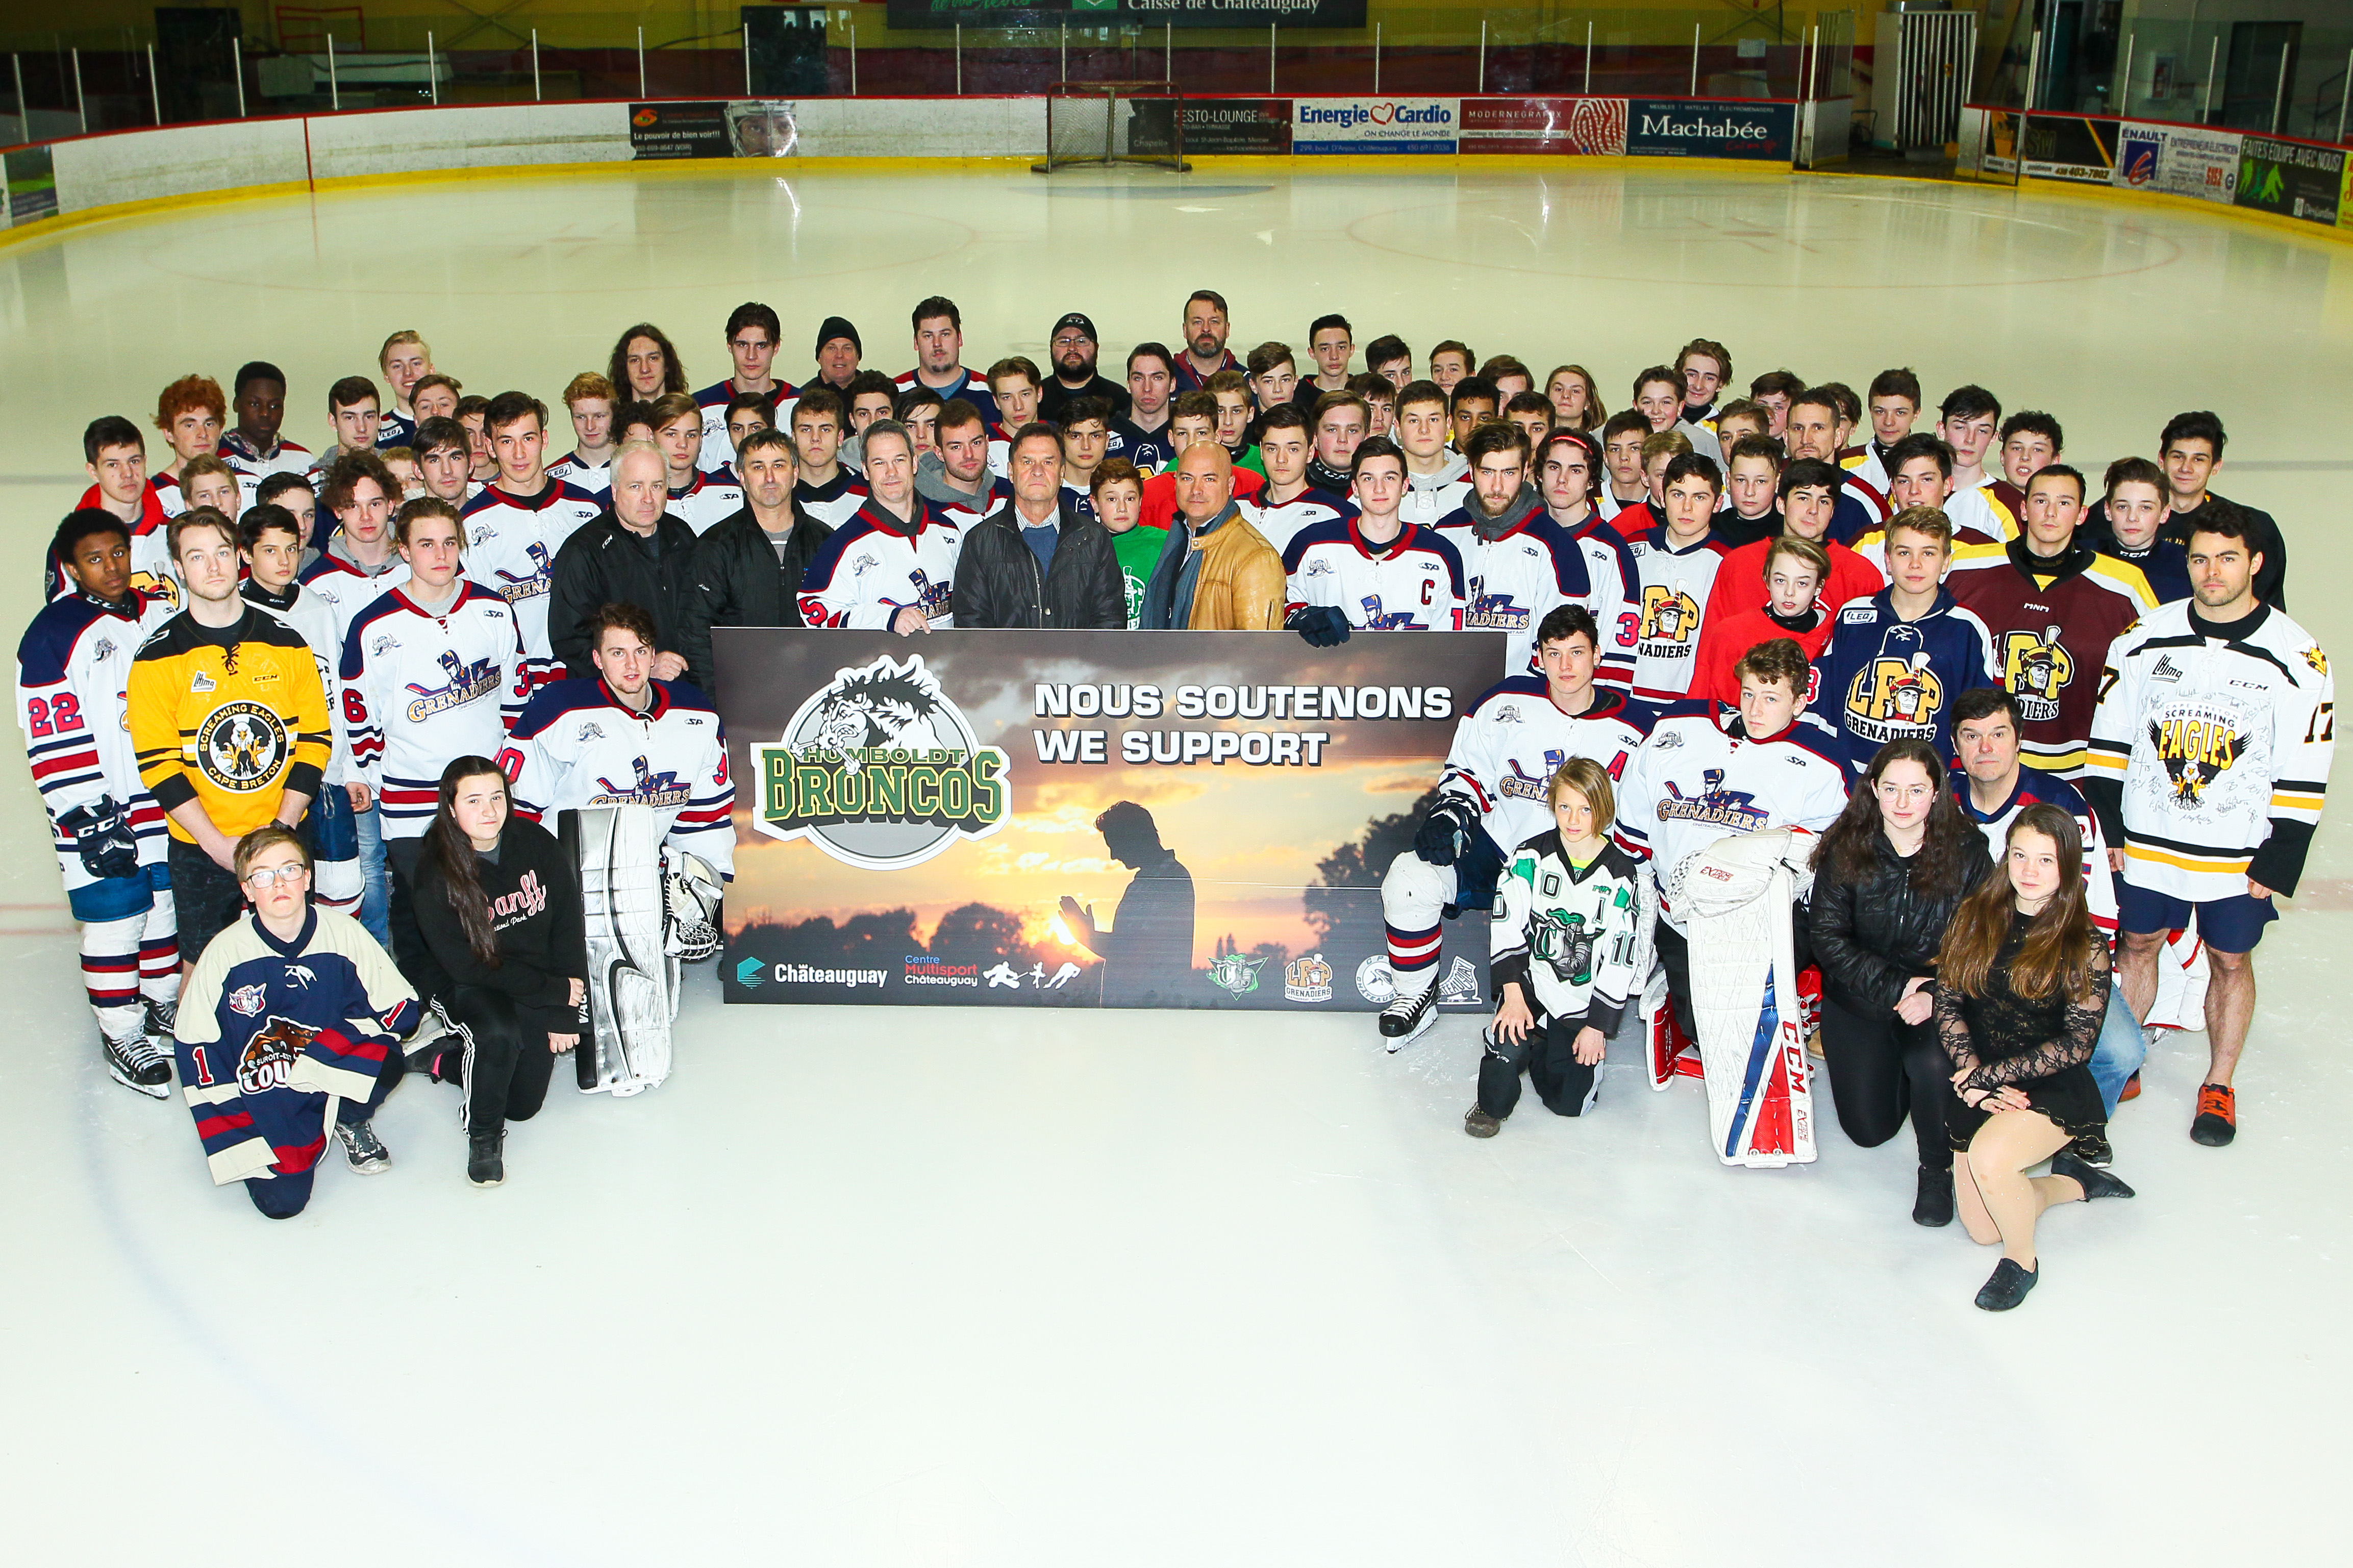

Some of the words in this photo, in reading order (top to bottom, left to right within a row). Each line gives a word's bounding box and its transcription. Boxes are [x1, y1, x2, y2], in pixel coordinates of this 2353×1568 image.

[1300, 104, 1370, 128] Energie
[1394, 104, 1451, 123] Cardio
[1640, 114, 1768, 139] Machabée
[634, 132, 643, 140] Le
[644, 131, 670, 141] pouvoir
[683, 131, 698, 139] bien
[499, 577, 552, 605] GRENA
[1420, 578, 1435, 605] C
[1465, 612, 1530, 629] NADIERS
[1638, 643, 1692, 659] NADIERS
[406, 669, 502, 723] GRENADIERS
[2229, 680, 2267, 691] CCM
[27, 691, 85, 739] 22
[1033, 683, 1163, 720] NOUS
[1175, 685, 1453, 721] SOUTENONS
[199, 703, 249, 753] SCREAMING
[250, 705, 285, 744] EAGLES
[2165, 710, 2236, 728] SCREAMING
[2304, 702, 2334, 744] 17
[802, 747, 966, 764] HUMBOLDT
[1032, 729, 1108, 765] WE
[1121, 731, 1330, 766] SUPPORT
[2157, 718, 2237, 770] EAGLES
[208, 765, 236, 790] CAPE
[240, 758, 282, 790] BRETON
[762, 747, 1005, 824] BRONCOS
[78, 810, 123, 838] CC
[1657, 798, 1768, 827] GRENADIERS
[510, 915, 528, 927] Park
[905, 955, 940, 965] Centre
[905, 962, 978, 976] Multisport
[774, 963, 888, 988] Châteauguay
[905, 975, 978, 987] Châteauguay
[1286, 987, 1331, 998] GRENADIERS
[192, 1046, 215, 1085] 1
[1783, 1019, 1807, 1094] CCM
